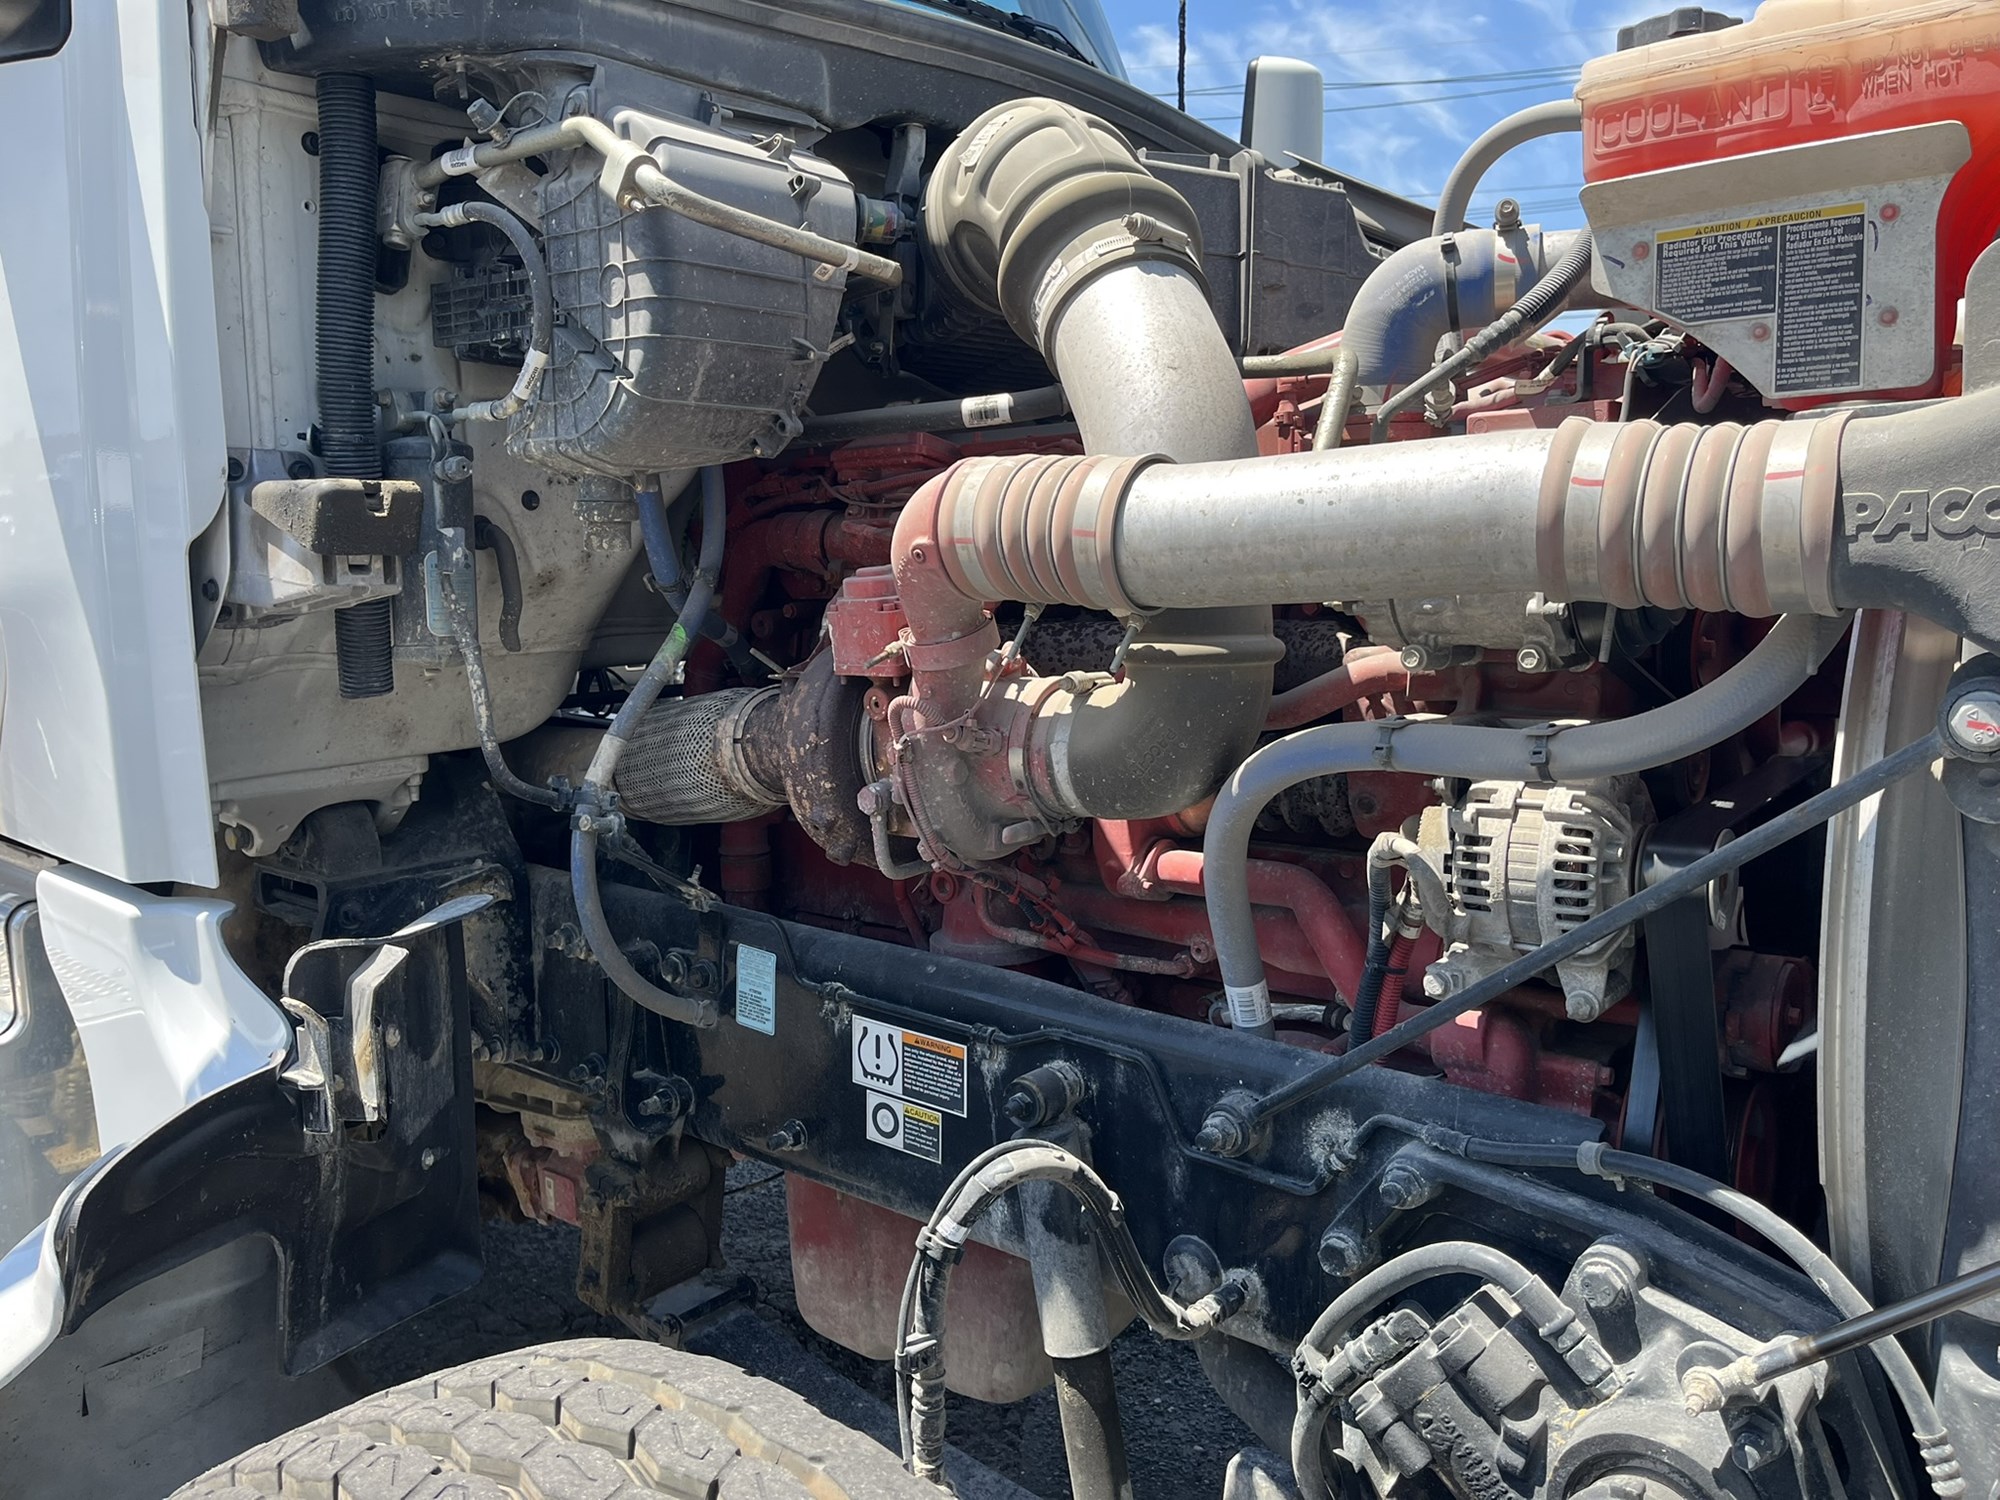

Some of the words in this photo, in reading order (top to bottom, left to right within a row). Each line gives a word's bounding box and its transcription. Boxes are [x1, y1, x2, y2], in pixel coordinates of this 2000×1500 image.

[1861, 55, 1885, 73] DO
[1897, 44, 1935, 66] NOT
[1862, 64, 1911, 96] WHEN
[1923, 58, 1961, 84] HOT
[1600, 77, 1777, 143] COOLANT
[1703, 222, 1741, 234] CAUTION
[1765, 210, 1822, 225] PRECAUCION
[1662, 239, 1698, 251] Radiator
[1701, 237, 1714, 245] Fill
[1717, 229, 1761, 243] Procedure
[1662, 245, 1699, 259] Required
[1702, 243, 1716, 252] For
[1720, 240, 1737, 249] This
[1740, 234, 1772, 247] Vehicle
[1786, 232, 1799, 241] Para
[920, 1039, 952, 1053] WARNING
[910, 1108, 940, 1123] CAUTION
